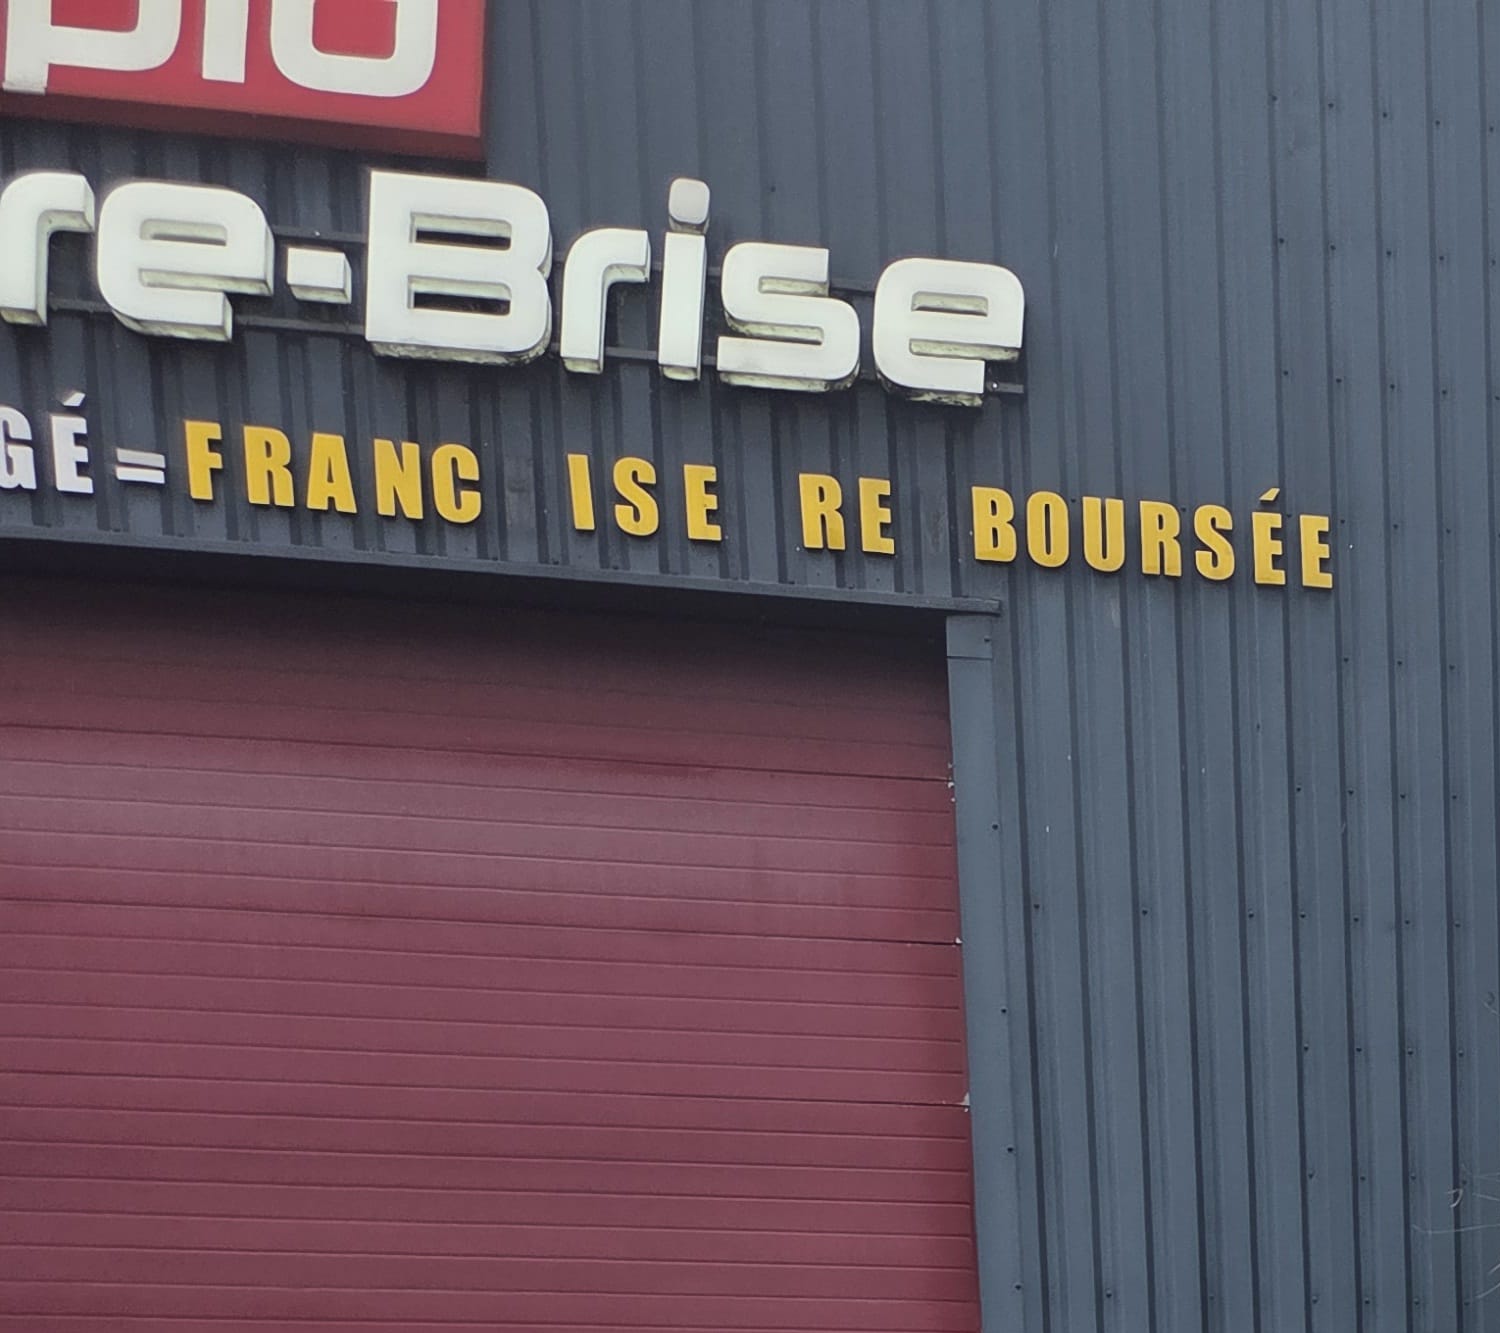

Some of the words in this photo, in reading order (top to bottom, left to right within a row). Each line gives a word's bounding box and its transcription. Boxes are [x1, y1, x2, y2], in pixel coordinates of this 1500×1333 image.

[567, 453, 722, 541] ISE
[799, 473, 895, 555] RE
[971, 486, 1333, 588] BOURSÉE
